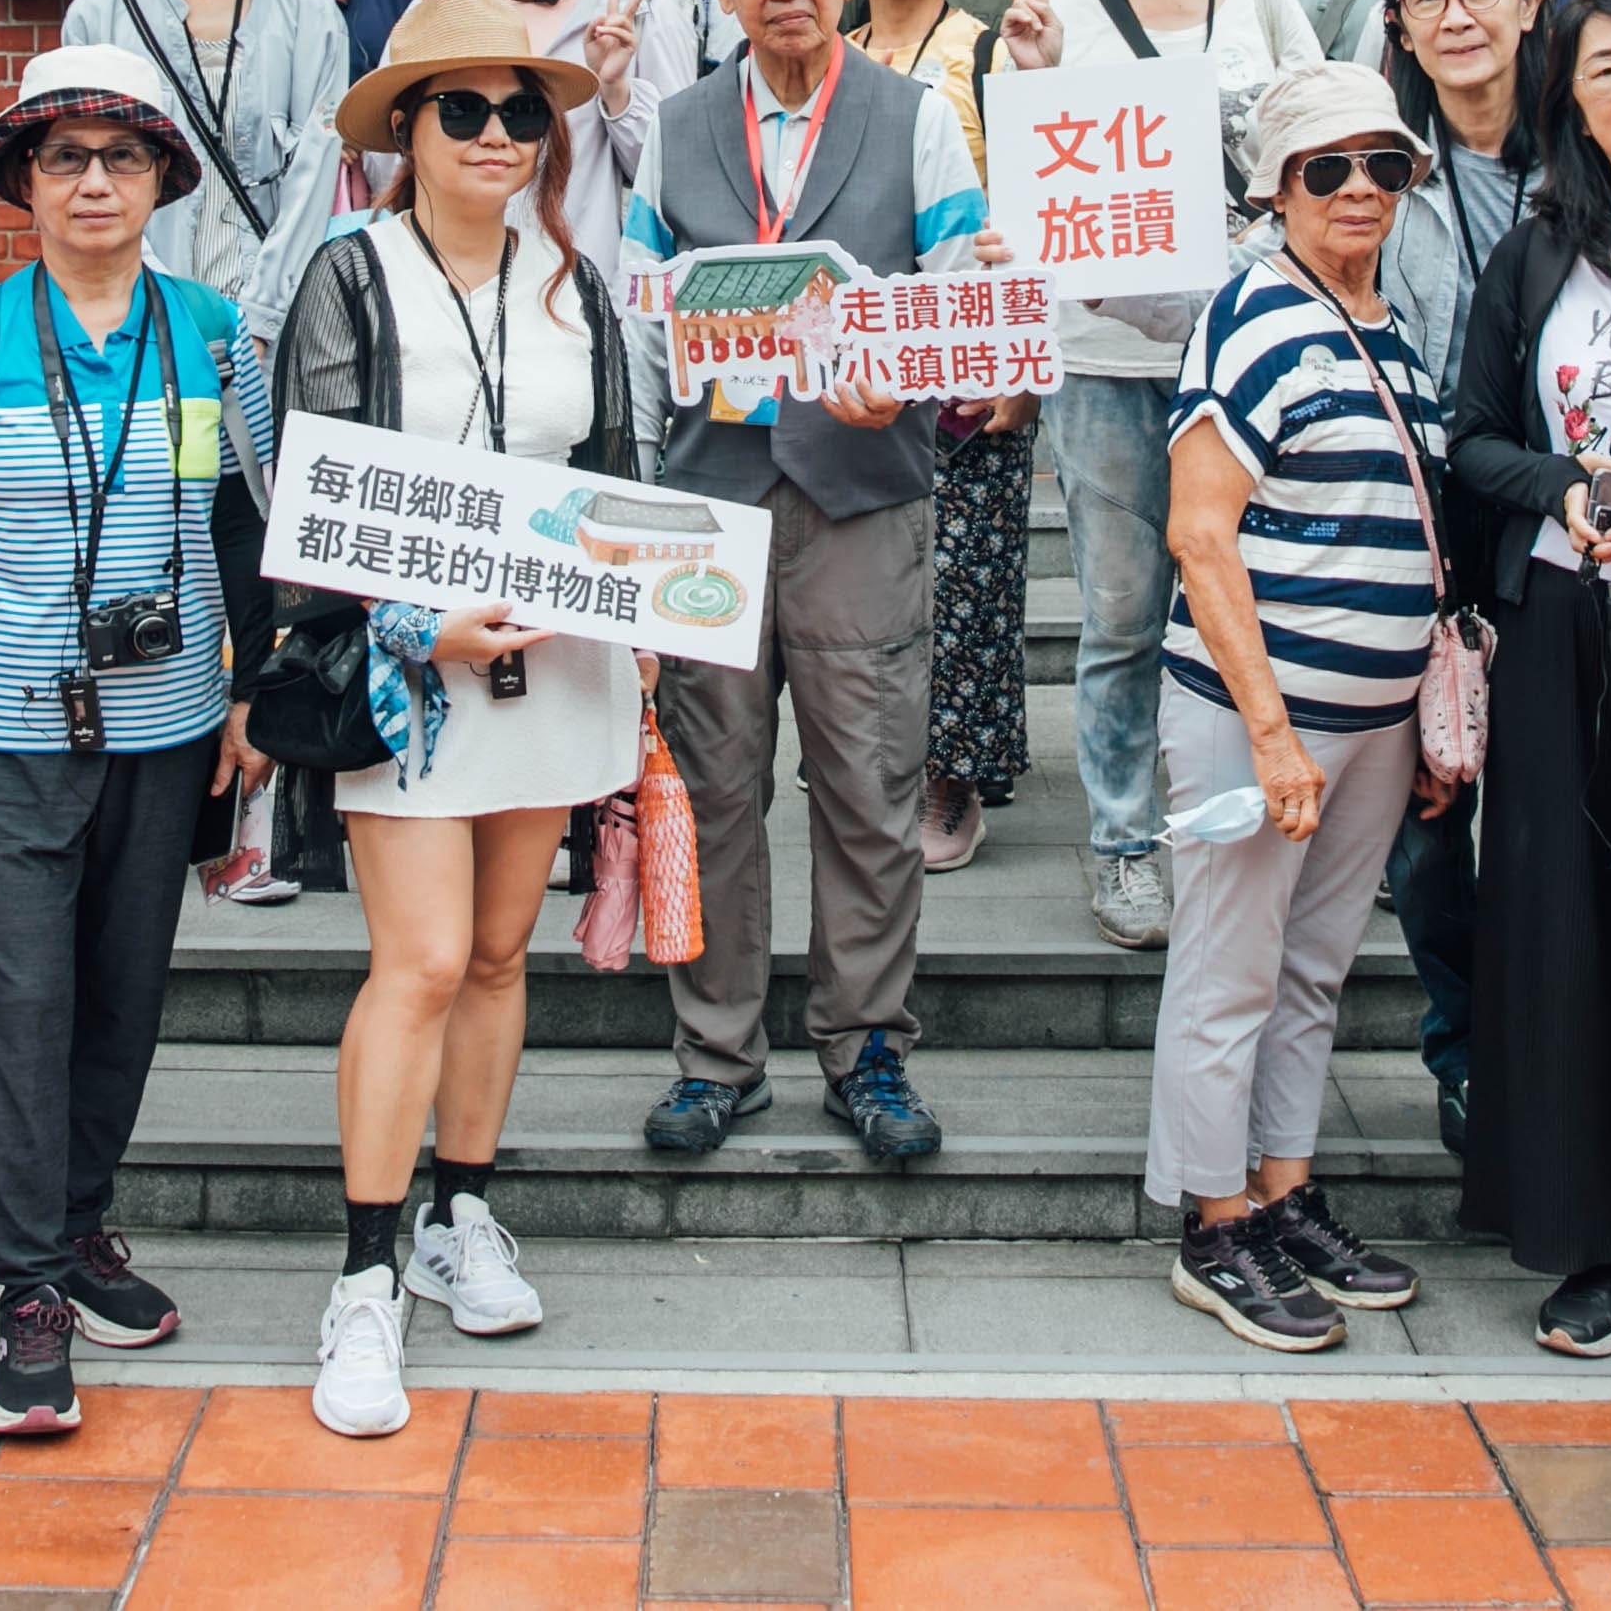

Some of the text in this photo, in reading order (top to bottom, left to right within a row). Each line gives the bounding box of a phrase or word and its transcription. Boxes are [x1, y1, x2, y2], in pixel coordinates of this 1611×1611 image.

[1033, 105, 1173, 179] 文化
[1037, 189, 1178, 263] 旅讀
[840, 277, 1050, 335] 走讀潮藝
[844, 337, 1054, 392] 小鎮時光
[306, 453, 505, 536] 每個鄉鎮
[295, 513, 643, 625] 都是我的博物館
